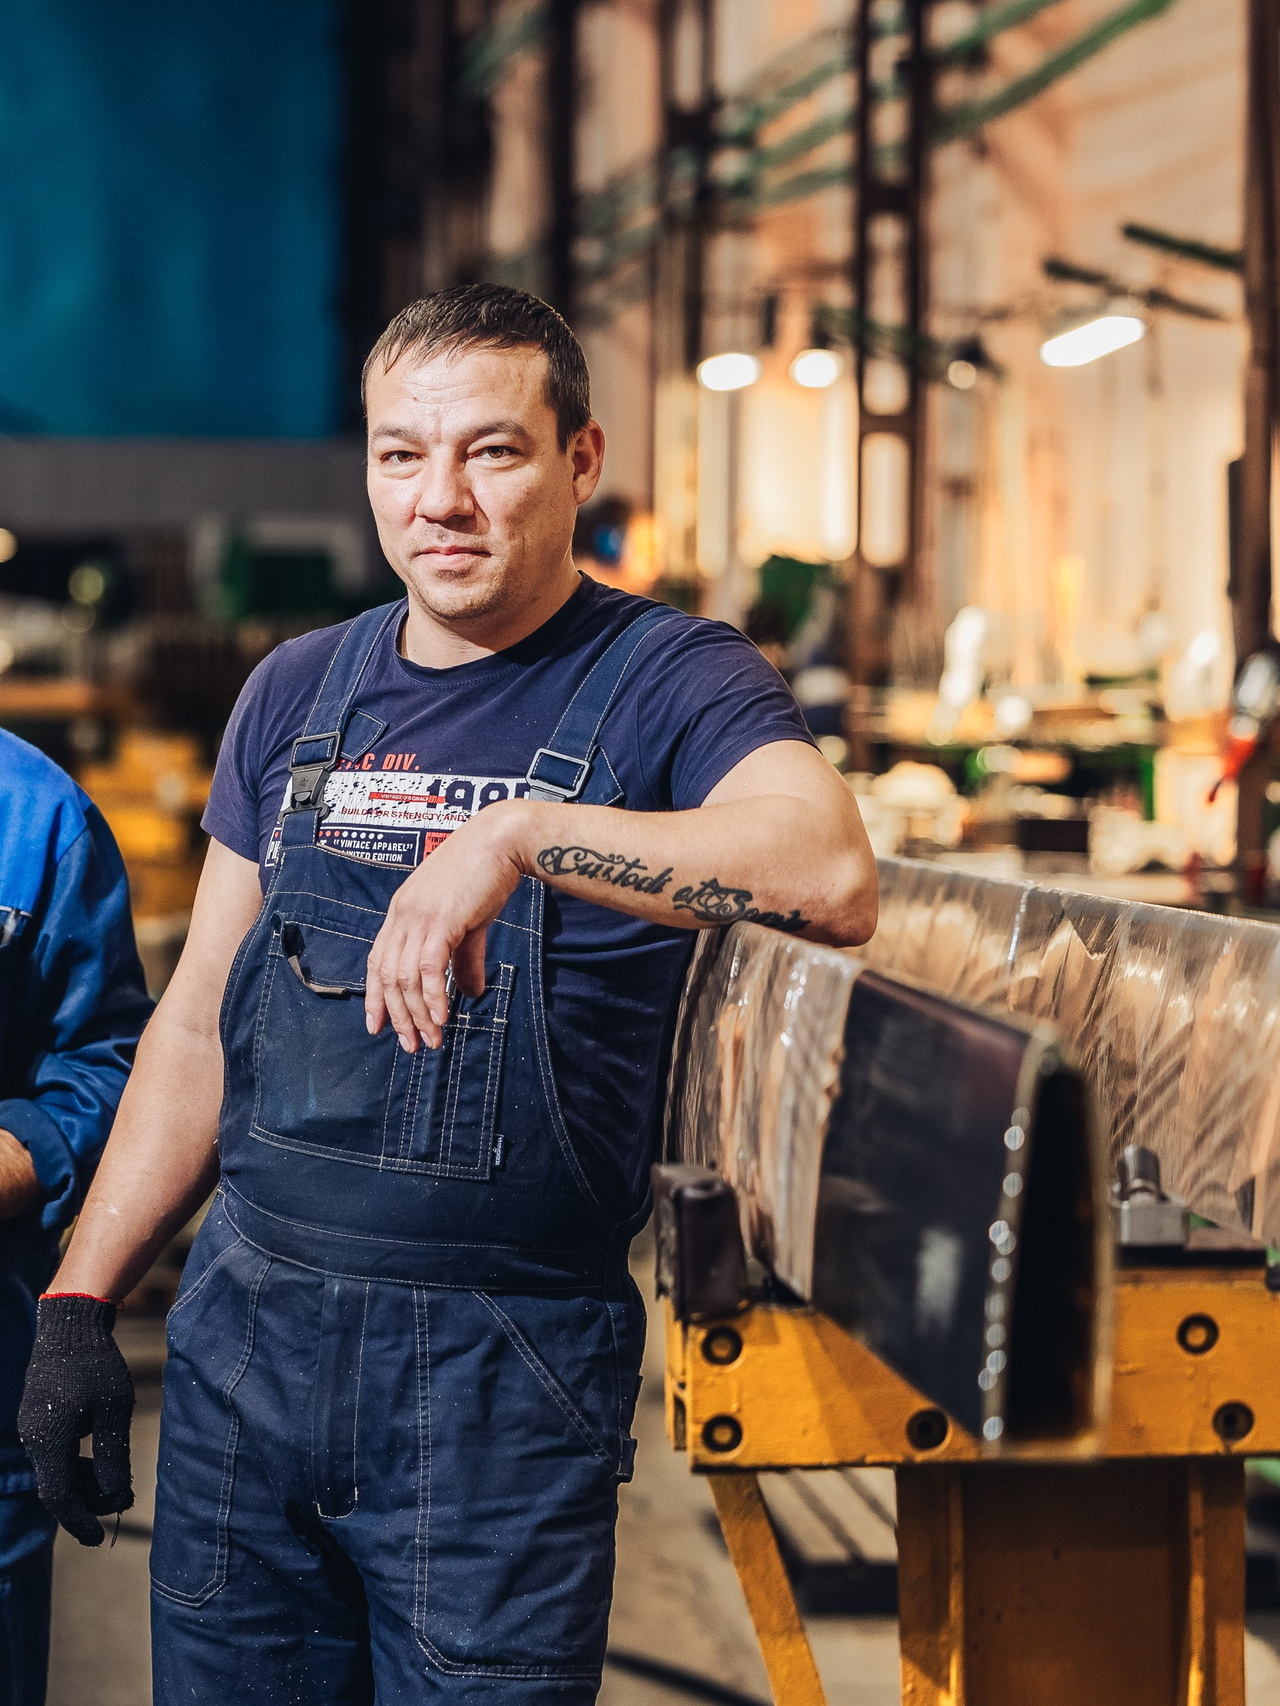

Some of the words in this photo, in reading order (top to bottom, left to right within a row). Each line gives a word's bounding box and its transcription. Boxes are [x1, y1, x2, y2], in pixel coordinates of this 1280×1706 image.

[381, 753, 420, 771] DIV.
[341, 807, 368, 816] BUILD
[371, 809, 389, 818] FOR
[443, 814, 465, 823] AND
[372, 853, 403, 862] EDITION
